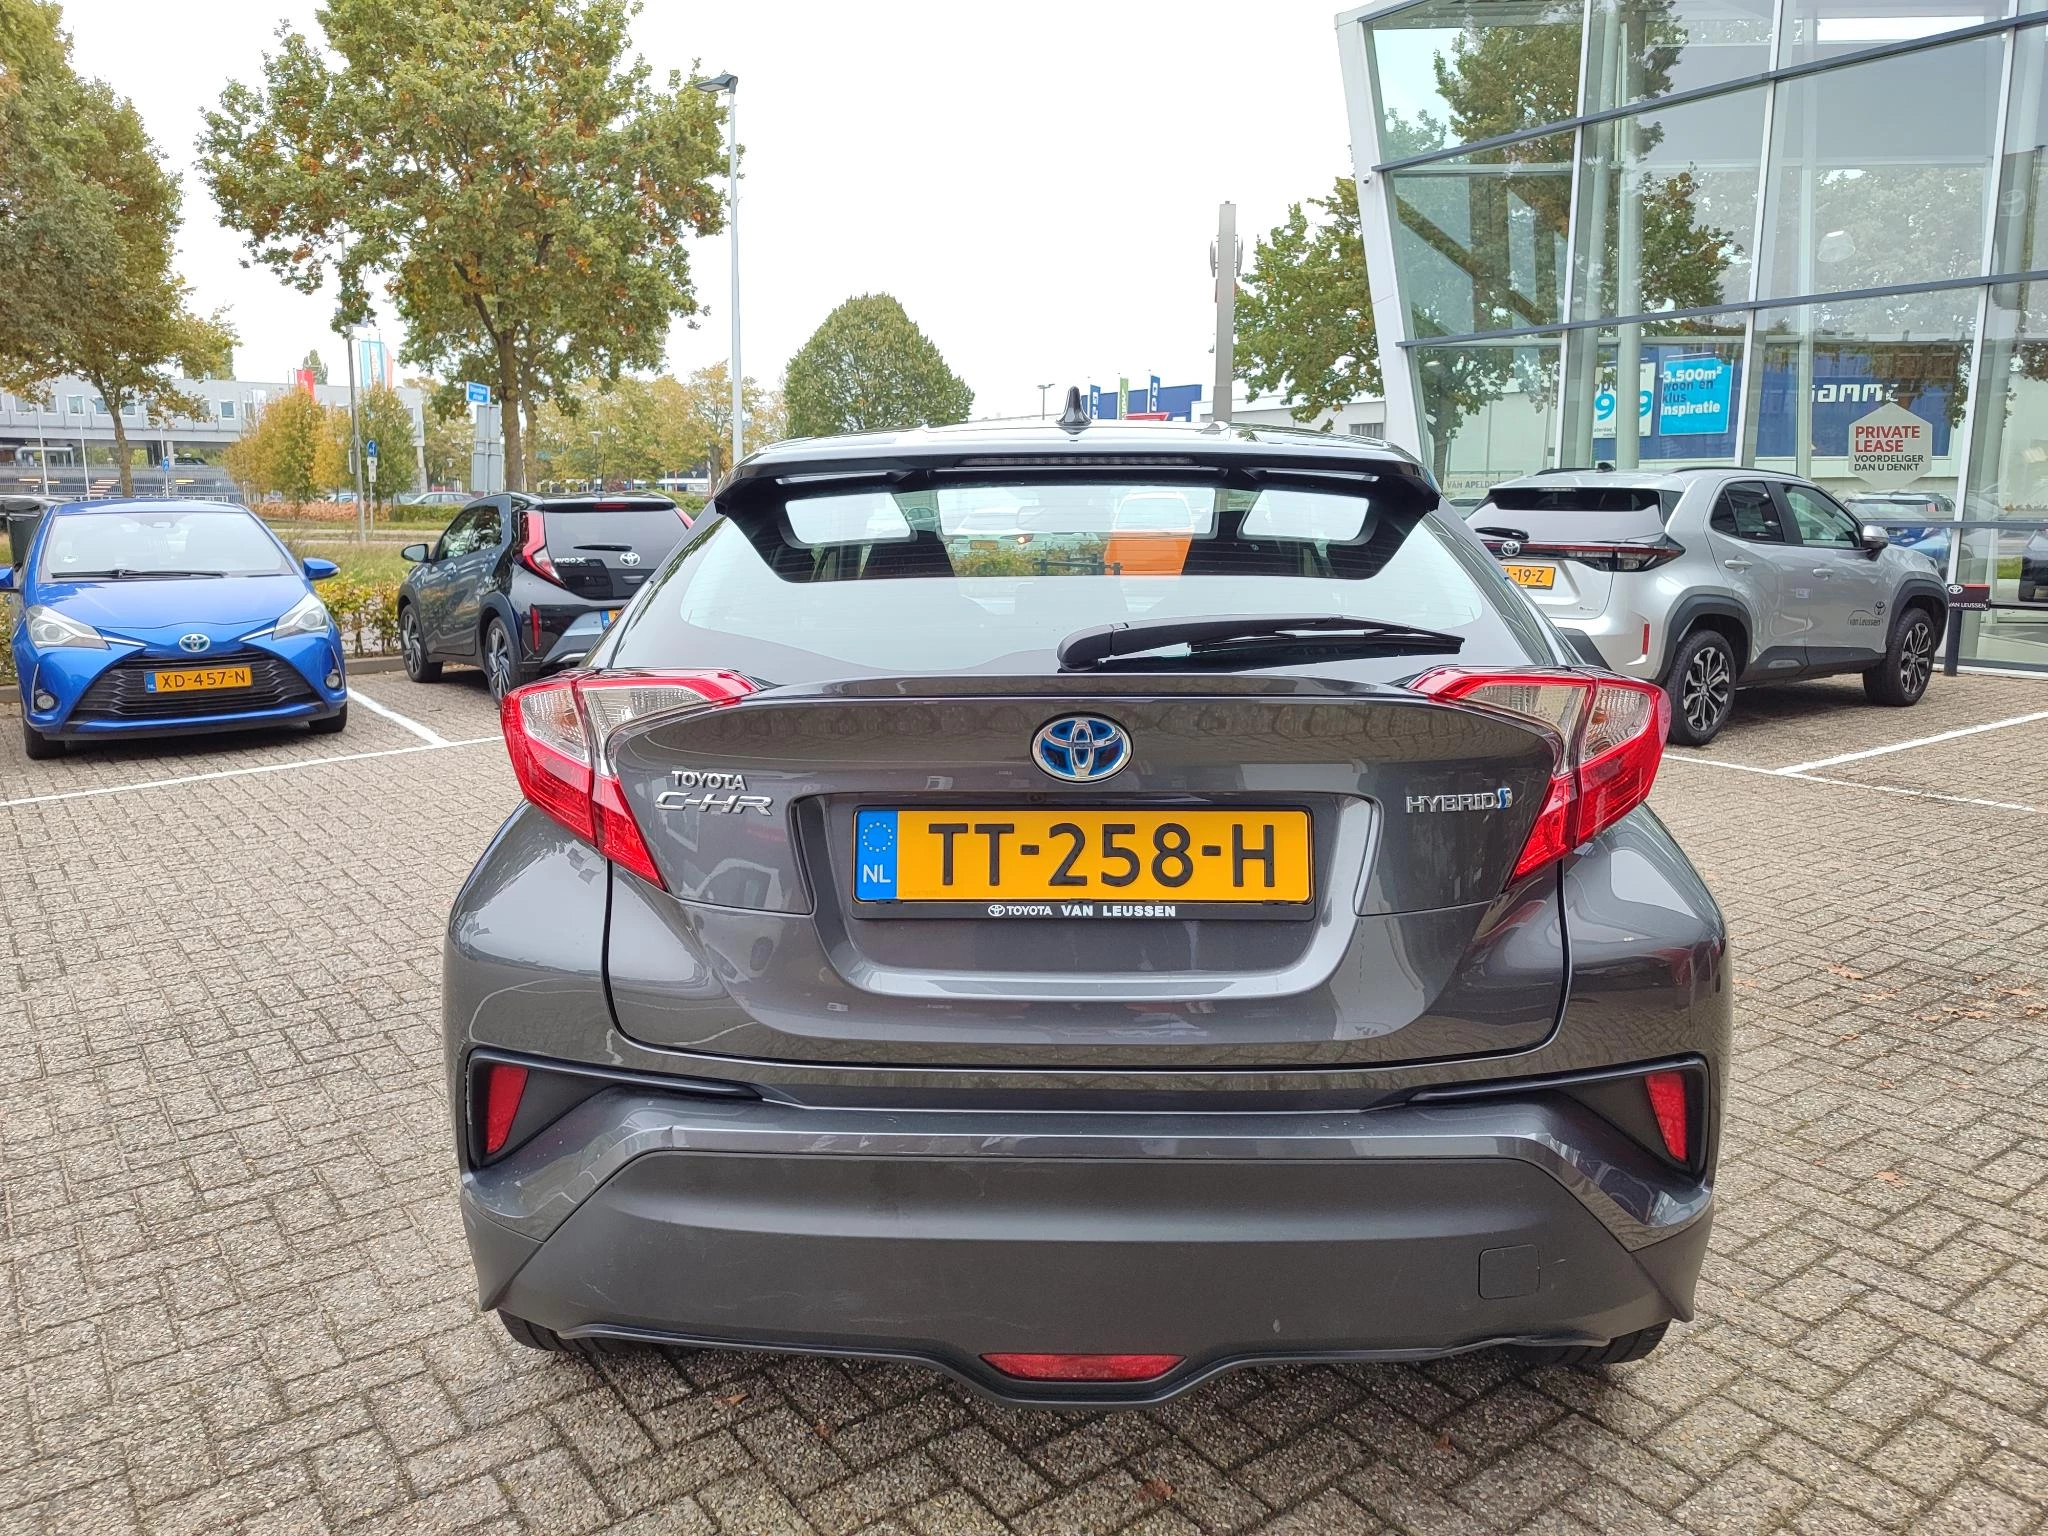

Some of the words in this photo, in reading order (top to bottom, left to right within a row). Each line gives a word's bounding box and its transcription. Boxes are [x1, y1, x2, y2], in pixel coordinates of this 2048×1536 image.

[1663, 381, 1694, 391] woon
[1699, 380, 1714, 390] en
[1662, 392, 1687, 403] klus
[1660, 400, 1720, 417] inspiratie
[1855, 426, 1920, 439] PRIVATE
[1855, 440, 1904, 453] LEASE
[1854, 454, 1925, 463] VOORDELIGER
[1854, 463, 1877, 472] DAN
[1877, 463, 1885, 472] U
[1886, 463, 1920, 472] DENKT
[161, 670, 246, 689] XD-457-N
[671, 770, 748, 791] TOYOTA
[655, 791, 773, 816] C-HR
[1406, 792, 1497, 813] HYBRID
[862, 863, 892, 884] NL
[928, 822, 1276, 888] TT-258-H
[1006, 905, 1053, 916] TOYOTA
[1060, 905, 1094, 917] VAN
[1102, 905, 1176, 917] LEUSSEN
